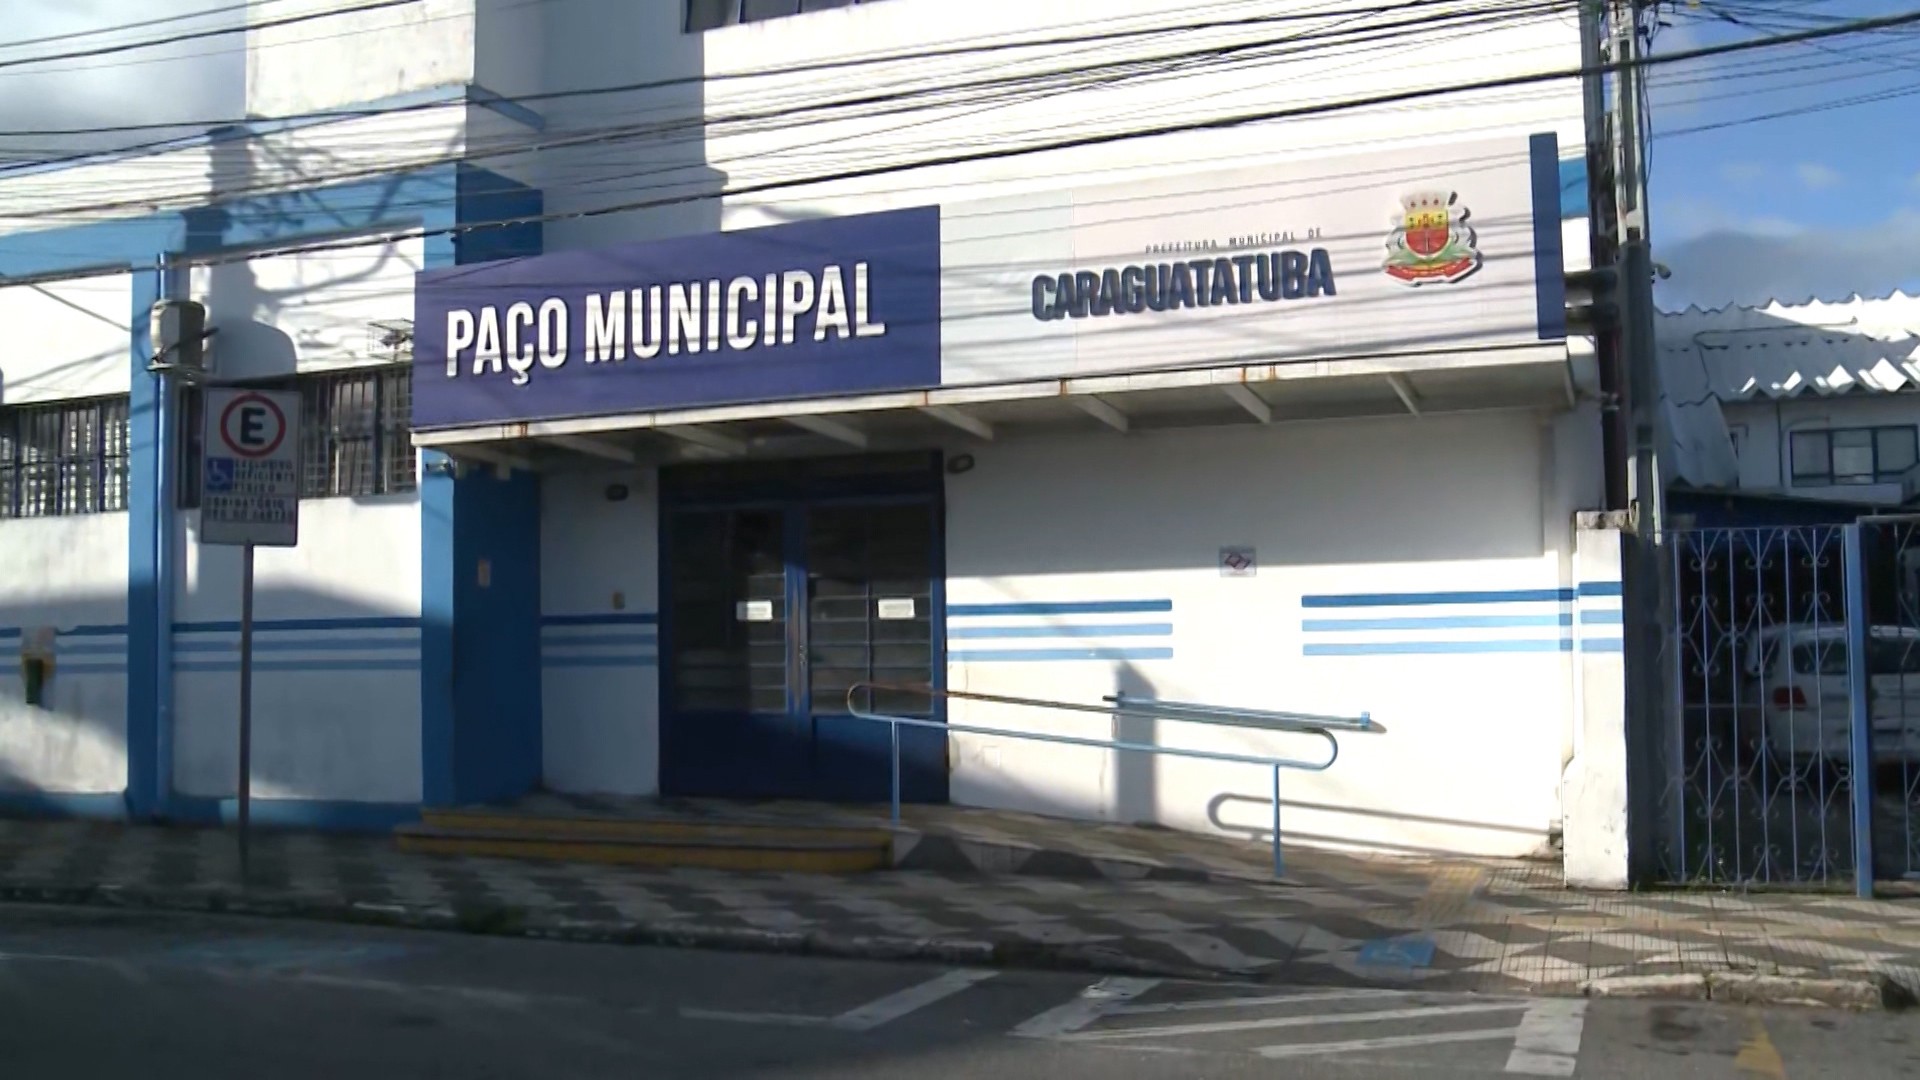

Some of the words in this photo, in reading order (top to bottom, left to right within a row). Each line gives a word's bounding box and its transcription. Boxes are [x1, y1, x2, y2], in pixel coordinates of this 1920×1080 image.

[1145, 239, 1217, 254] PREFEITURA
[1229, 231, 1295, 248] MUNICIPAL
[1307, 227, 1321, 240] DE
[1032, 247, 1337, 321] CARAGUATATUBA
[446, 297, 568, 385] PAÇO
[584, 262, 886, 363] MUNICIPAL
[241, 407, 265, 445] E
